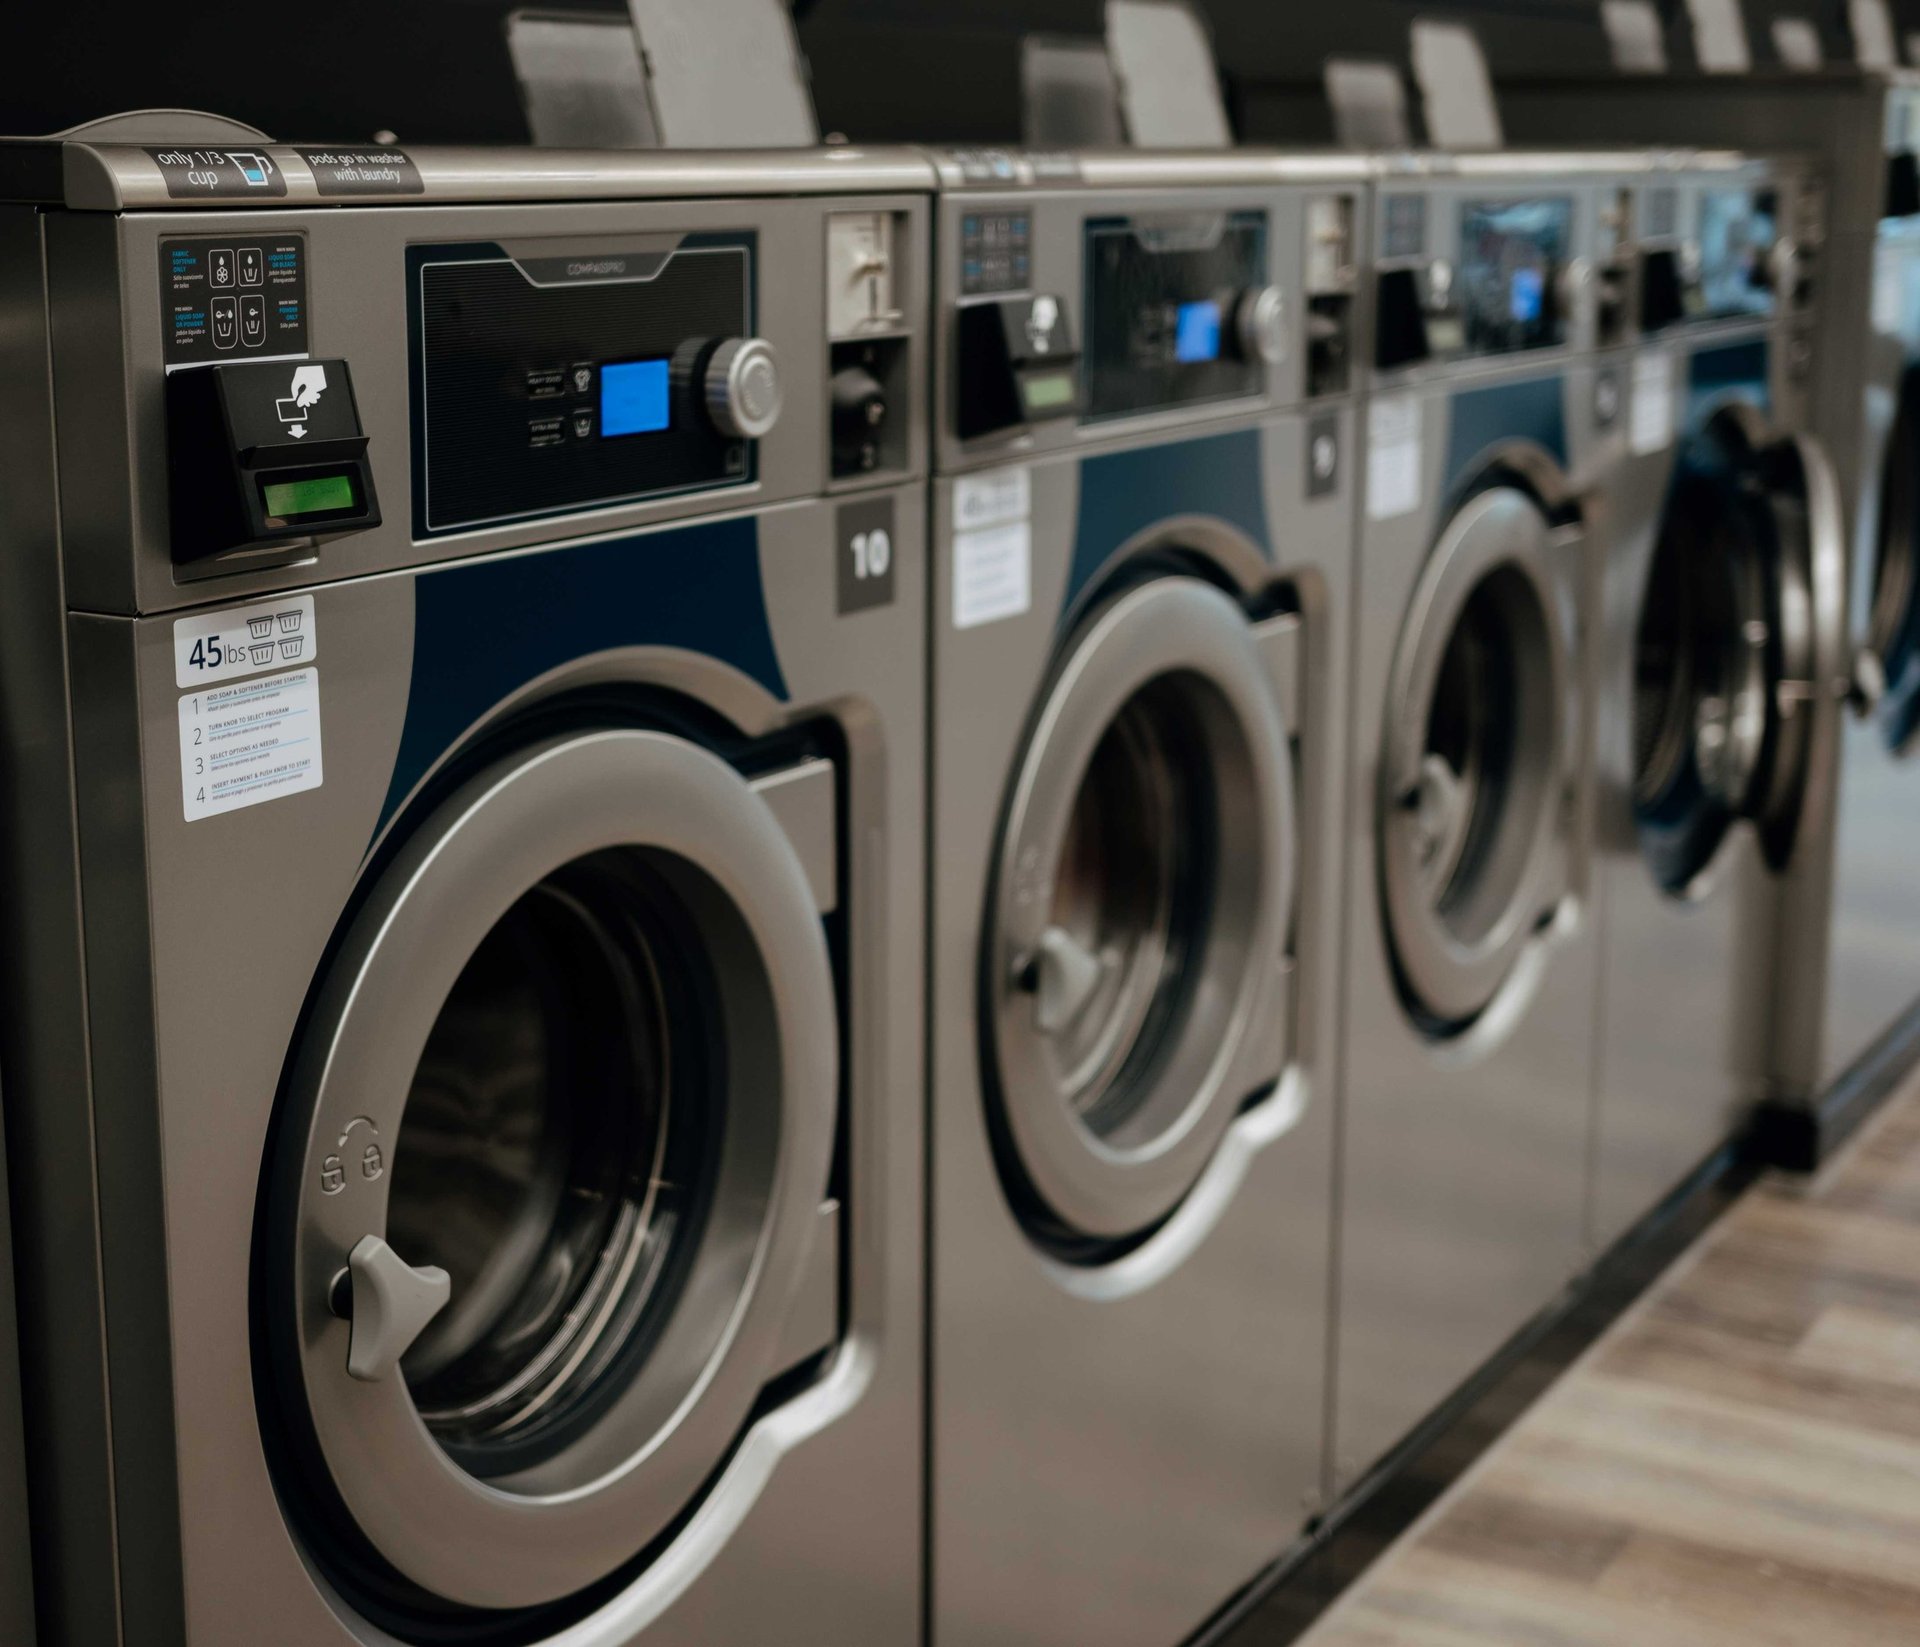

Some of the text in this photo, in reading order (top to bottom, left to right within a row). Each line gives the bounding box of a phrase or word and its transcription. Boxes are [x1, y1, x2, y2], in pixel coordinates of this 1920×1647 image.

[158, 151, 225, 168] only 1/3
[308, 154, 406, 167] pods go in washer
[188, 171, 218, 189] cup
[334, 168, 400, 184] with laundry
[850, 528, 890, 580] 10
[189, 635, 246, 670] 45lbs
[219, 690, 232, 698] SOAP
[238, 684, 263, 694] SOFTENER
[264, 679, 282, 688] BEFORE
[284, 674, 307, 684] STARTING
[192, 698, 199, 715] 1
[208, 722, 222, 730] TURN
[223, 718, 238, 727] KNOB
[247, 712, 264, 722] SELECT
[265, 707, 290, 717] PROGRAM
[194, 728, 202, 745] 2
[210, 751, 228, 760] SELECT
[229, 745, 251, 756] OPTIONS
[260, 738, 279, 748] NEEDED
[195, 757, 204, 775] 3
[212, 781, 229, 790] INSERT
[230, 773, 253, 784] PAYMENT
[260, 769, 272, 777] PUSH
[274, 765, 287, 774] KNOB
[296, 759, 311, 768] START
[196, 787, 205, 803] 4
